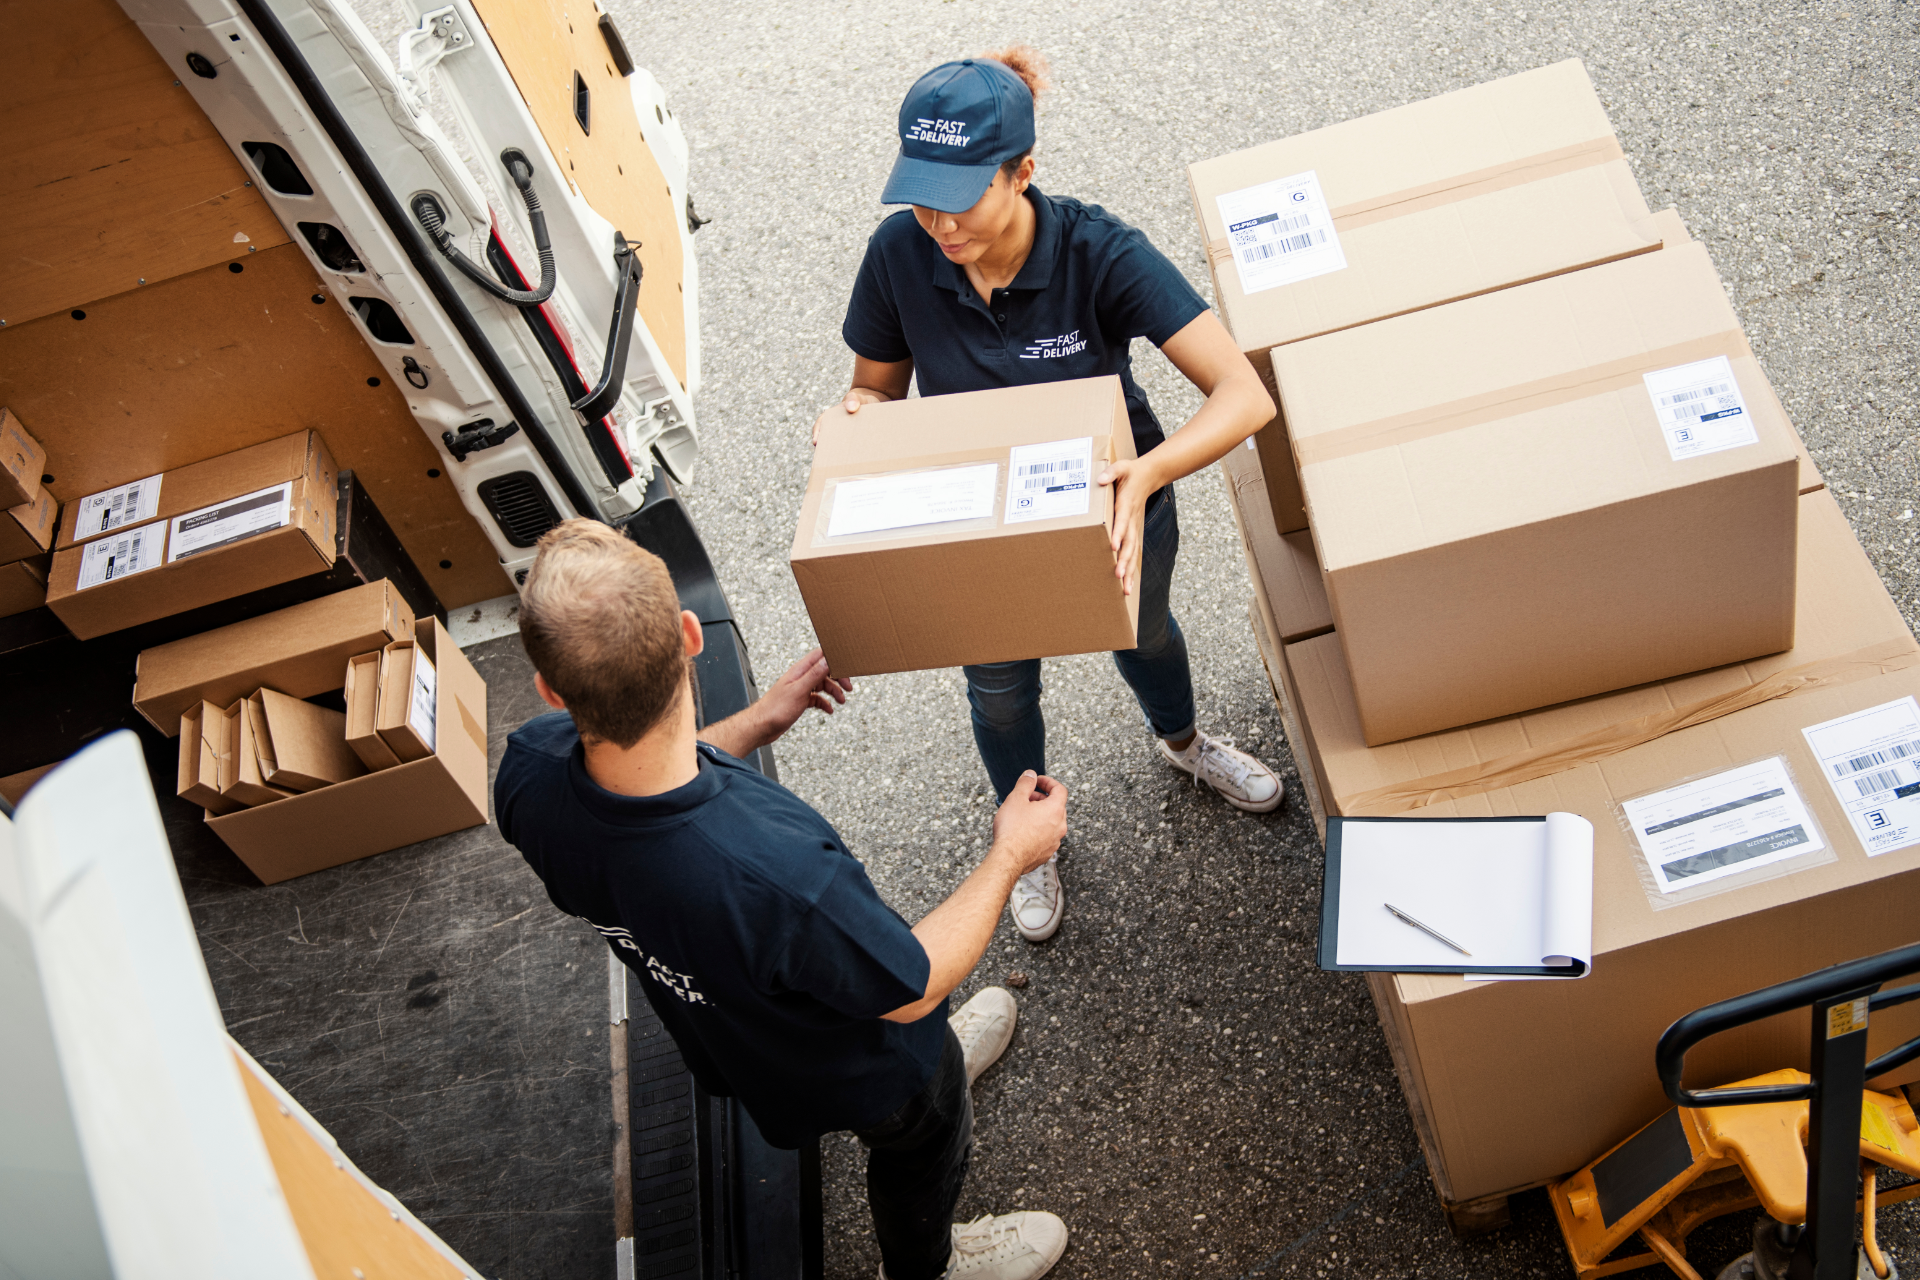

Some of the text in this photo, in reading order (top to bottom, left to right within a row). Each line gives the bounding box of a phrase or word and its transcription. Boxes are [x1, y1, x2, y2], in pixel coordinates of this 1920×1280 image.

[935, 119, 966, 134] FAST
[920, 130, 970, 147] DELIVERY
[1292, 192, 1304, 201] G
[1232, 220, 1258, 230] W-PKG
[1057, 330, 1080, 346] FAST
[1043, 340, 1087, 358] DELIVERY
[1680, 430, 1689, 441] E
[1020, 499, 1030, 507] G
[186, 514, 208, 526] PACKING
[1870, 812, 1885, 826] E
[1774, 830, 1796, 839] Invoice
[1868, 830, 1896, 842] DELIVERY
[1769, 836, 1799, 850] INVOICE
[1875, 838, 1891, 848] FAST
